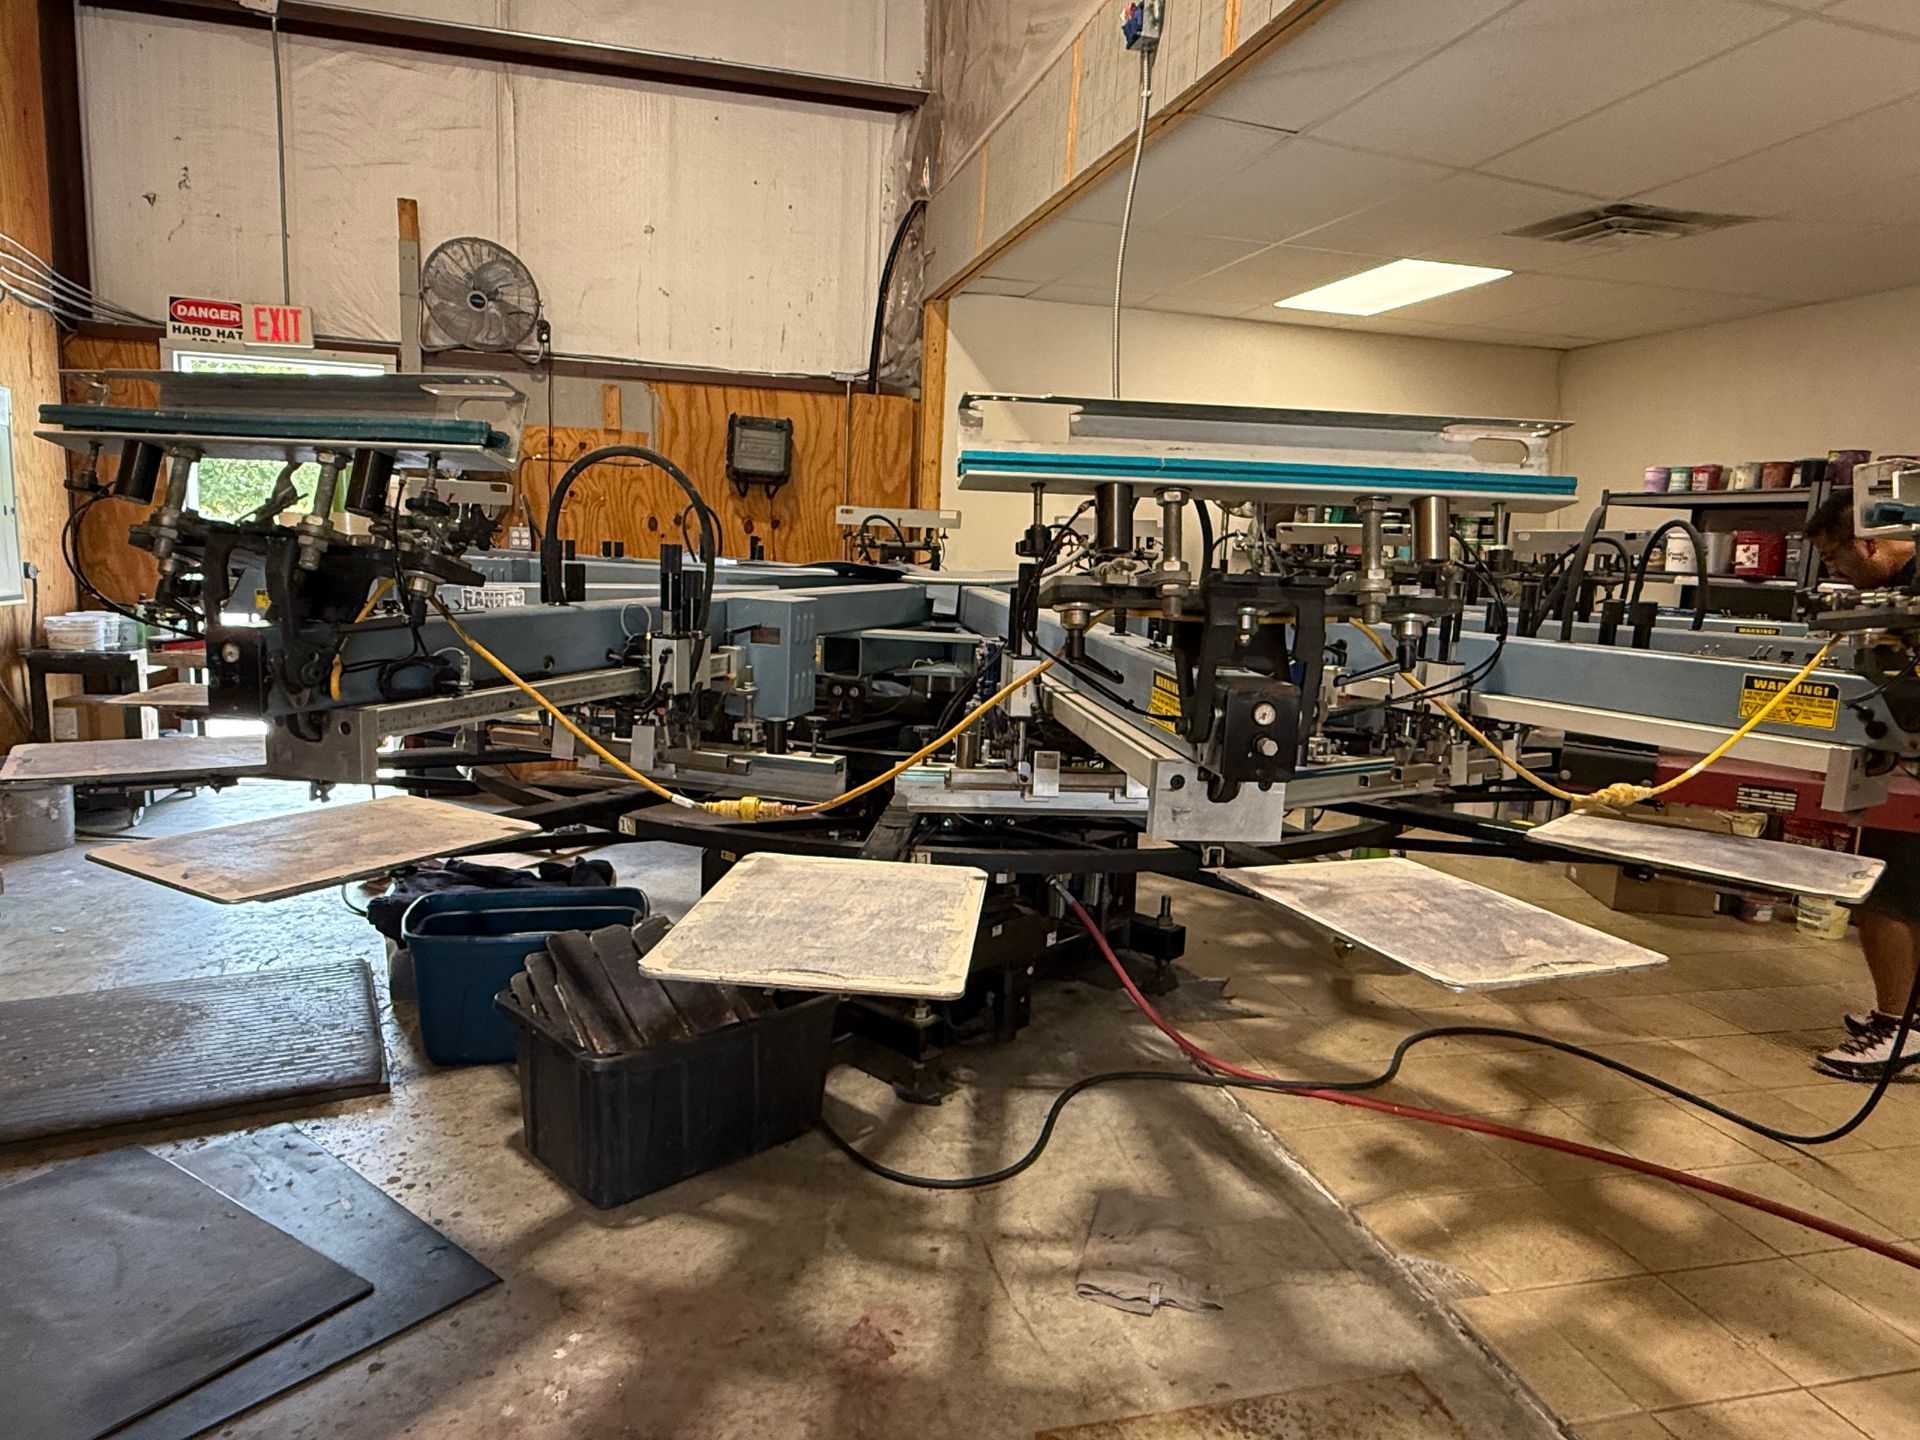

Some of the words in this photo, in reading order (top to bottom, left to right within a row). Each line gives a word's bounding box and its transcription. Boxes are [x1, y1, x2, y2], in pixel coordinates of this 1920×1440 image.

[176, 304, 241, 322] DANGER
[172, 324, 212, 337] HARD
[216, 329, 243, 341] HAT
[253, 304, 303, 343] EXIT
[1753, 678, 1830, 697] WARING!
